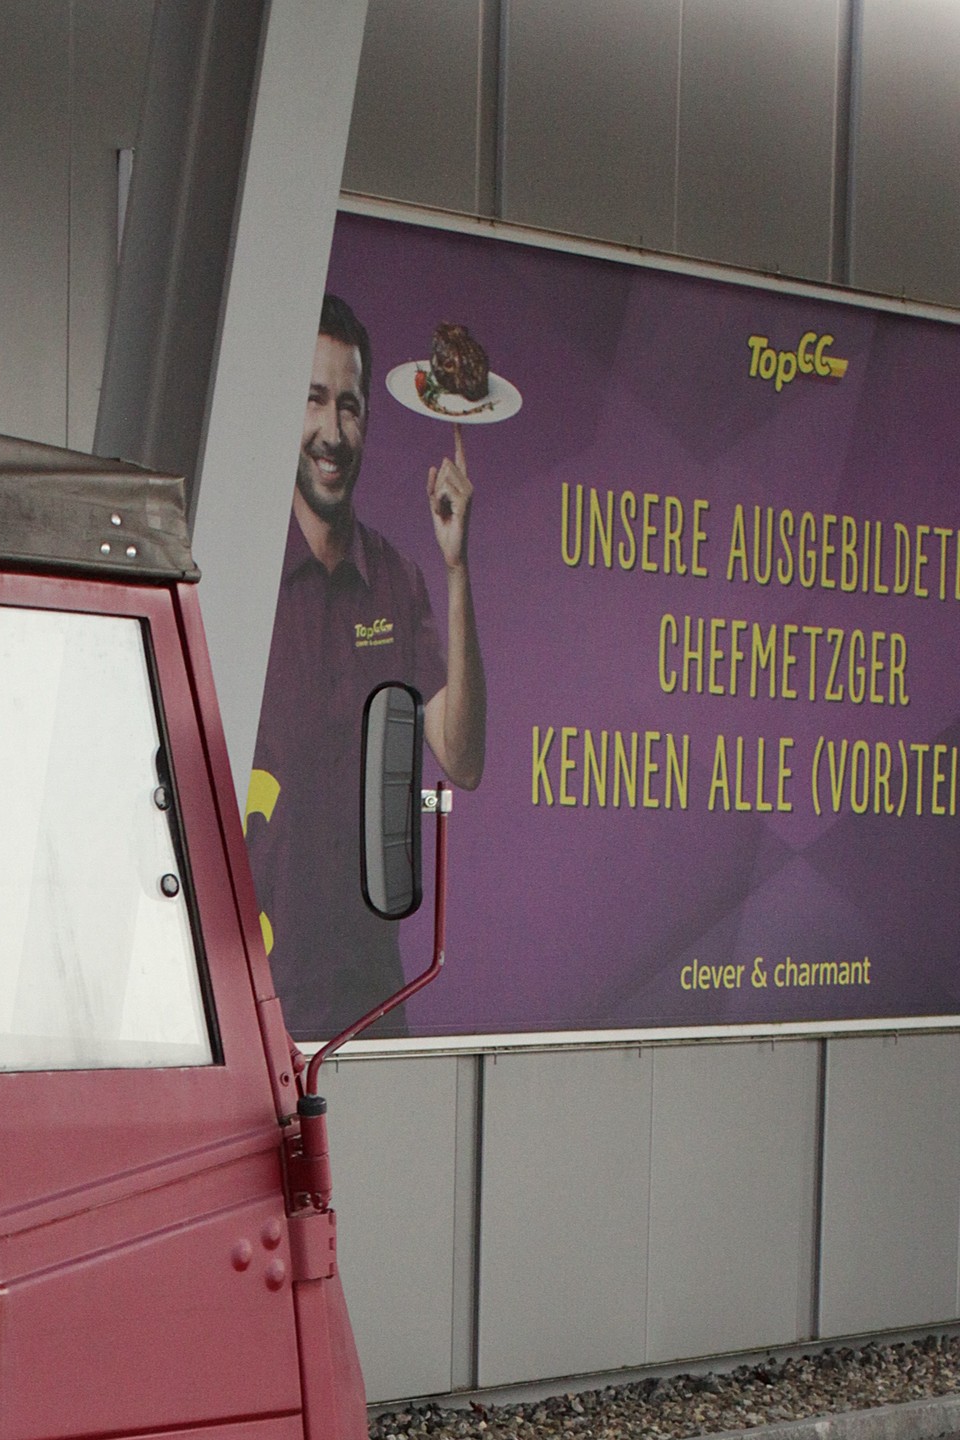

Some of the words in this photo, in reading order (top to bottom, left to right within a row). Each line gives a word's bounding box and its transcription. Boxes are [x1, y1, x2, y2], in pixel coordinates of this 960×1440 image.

[748, 332, 837, 392] TopCC
[561, 482, 710, 578] UNSERE
[354, 618, 390, 640] TopCC
[658, 612, 909, 706] CHEFMETZGER
[531, 725, 690, 810] KENNEN
[707, 734, 794, 813] ALLE
[811, 735, 958, 818] (VOR)TEI
[680, 958, 744, 990] clever
[750, 956, 768, 988] &
[774, 956, 871, 987] charmant
